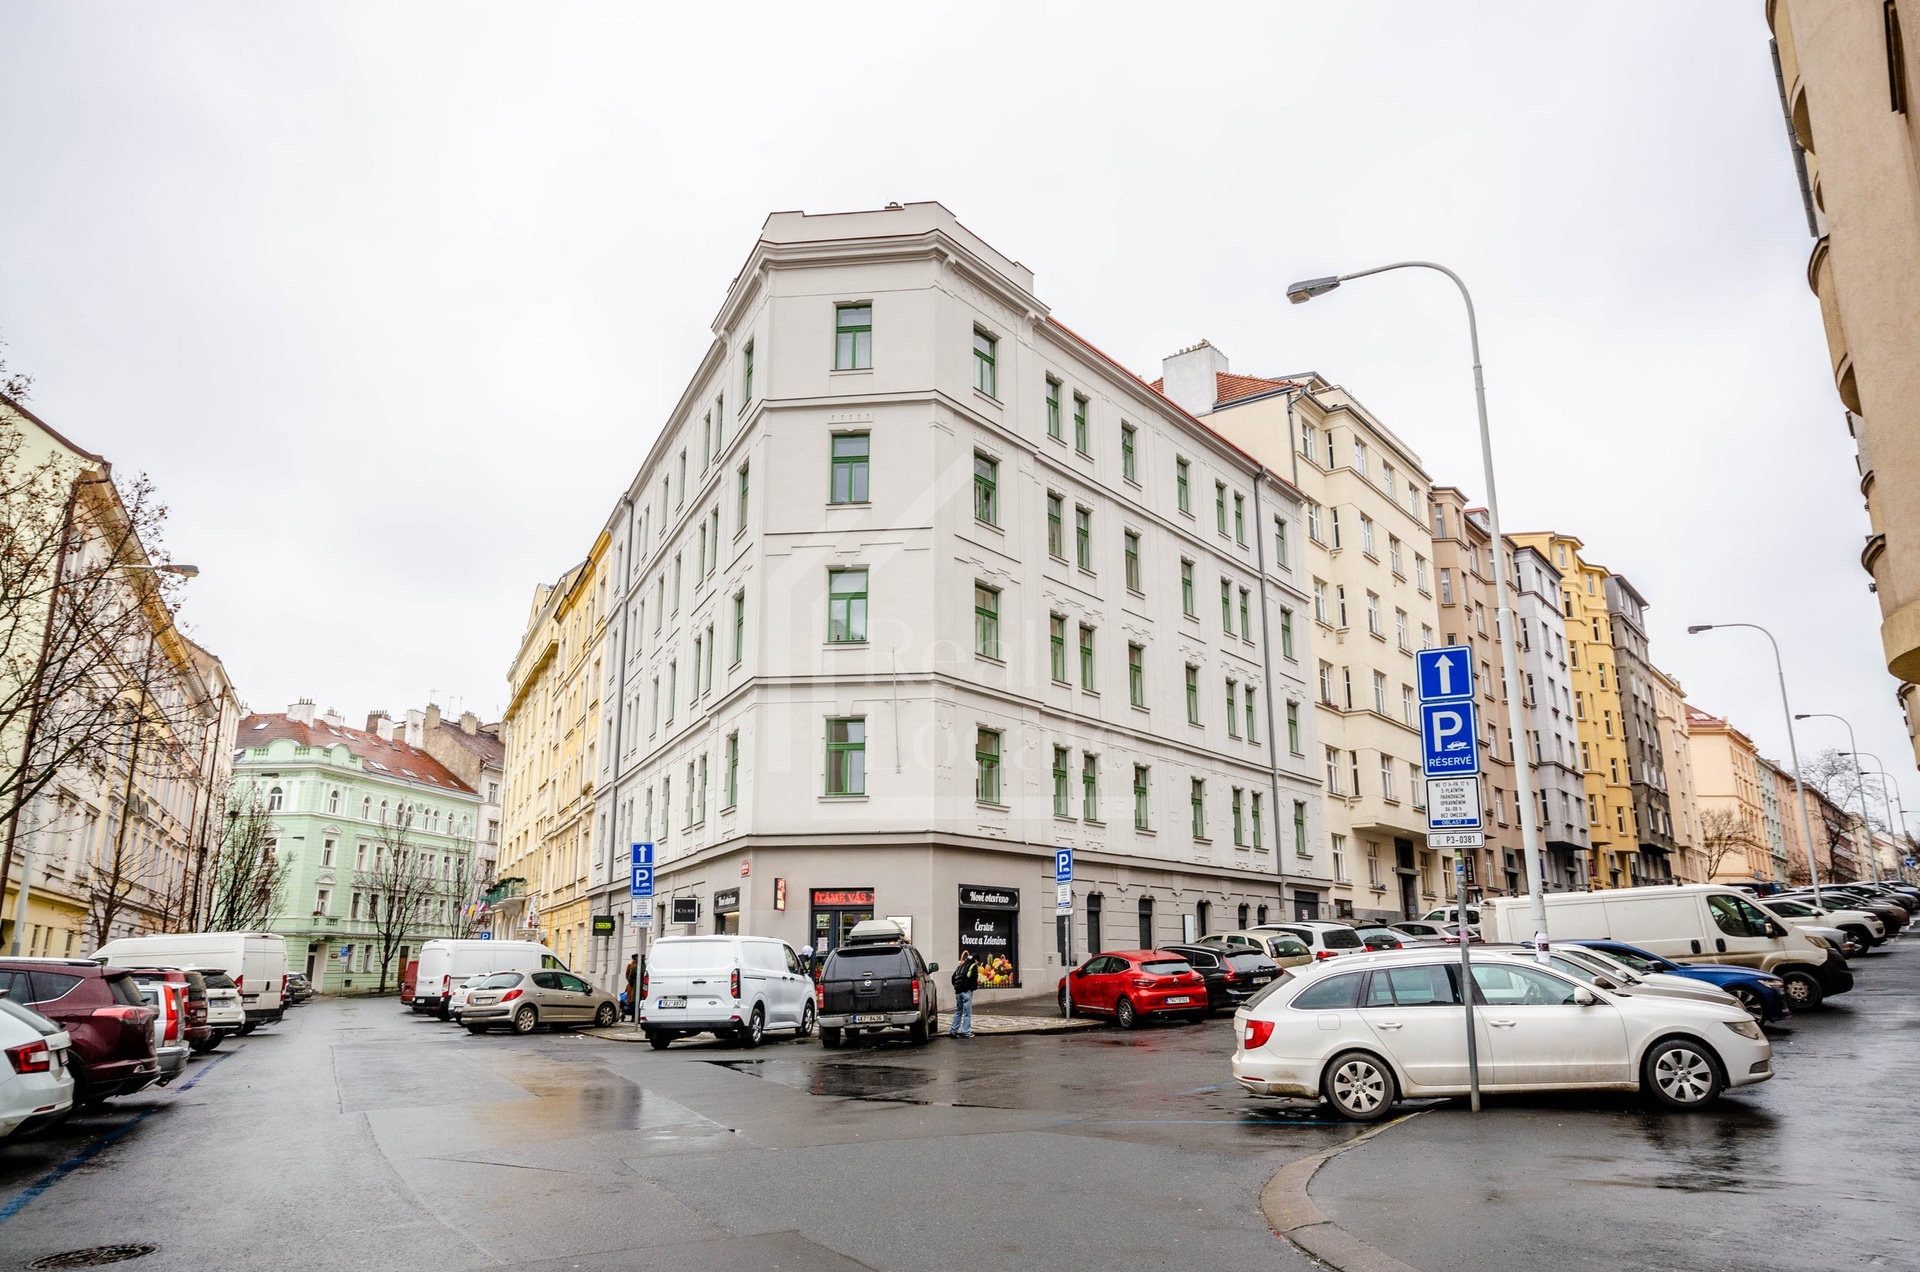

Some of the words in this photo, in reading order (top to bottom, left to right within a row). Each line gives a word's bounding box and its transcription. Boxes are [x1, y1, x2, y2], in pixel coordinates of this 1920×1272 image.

[1432, 711, 1463, 752] P
[1429, 754, 1473, 767] RÉSERVÉ
[1446, 835, 1476, 845] P3-0381
[1058, 853, 1069, 873] P
[635, 869, 649, 888] P
[847, 891, 867, 903] VÁS
[978, 937, 983, 945] a
